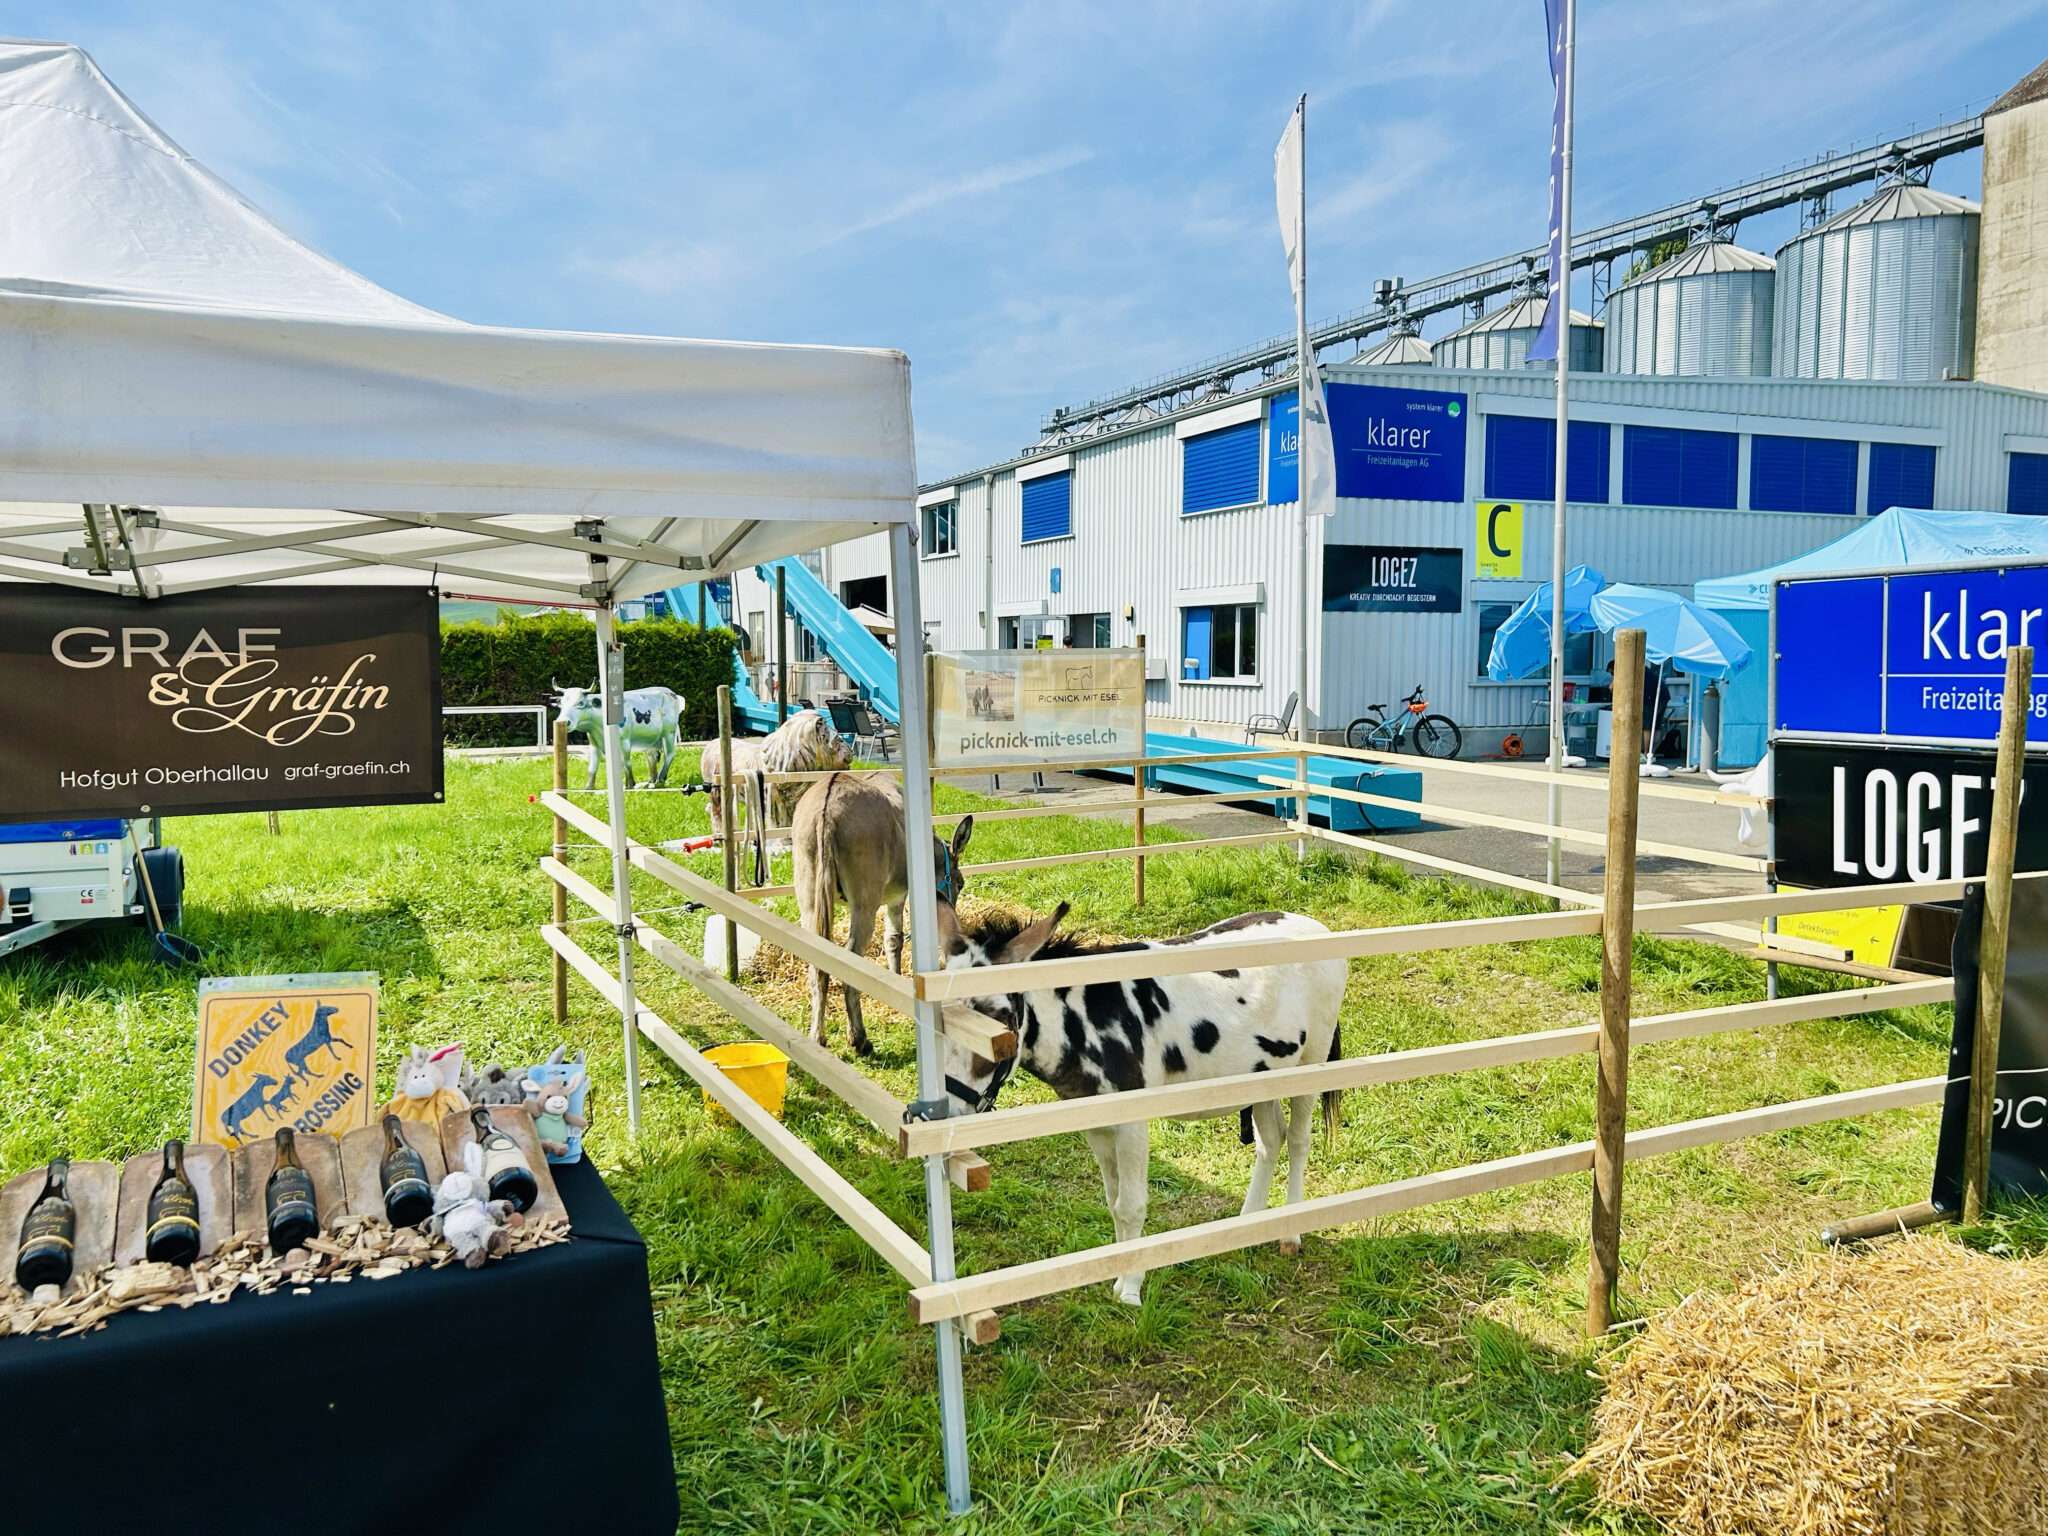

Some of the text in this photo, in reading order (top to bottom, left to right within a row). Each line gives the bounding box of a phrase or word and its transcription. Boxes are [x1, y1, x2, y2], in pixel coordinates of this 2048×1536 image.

[1406, 403, 1444, 412] system klarer
[1281, 430, 1298, 453] kla
[1368, 417, 1431, 449] klarer
[1368, 455, 1429, 469] Freizeitanlagen AG
[1487, 504, 1512, 558] C
[1372, 557, 1417, 588] LOGEZ
[1349, 592, 1371, 601] KREATIV
[51, 626, 281, 669] GRAF
[148, 653, 390, 747] & Gräfin
[1038, 692, 1121, 704] PICKNICK MIT ESEL
[1922, 686, 2048, 718] Freizeitaag
[960, 728, 1118, 754] picknick-mit-esel.ch
[60, 760, 411, 789] Hofgut Oberhallau graf-graefin.ch
[208, 1000, 290, 1079] DONKEY
[294, 1072, 365, 1135] ROSSING
